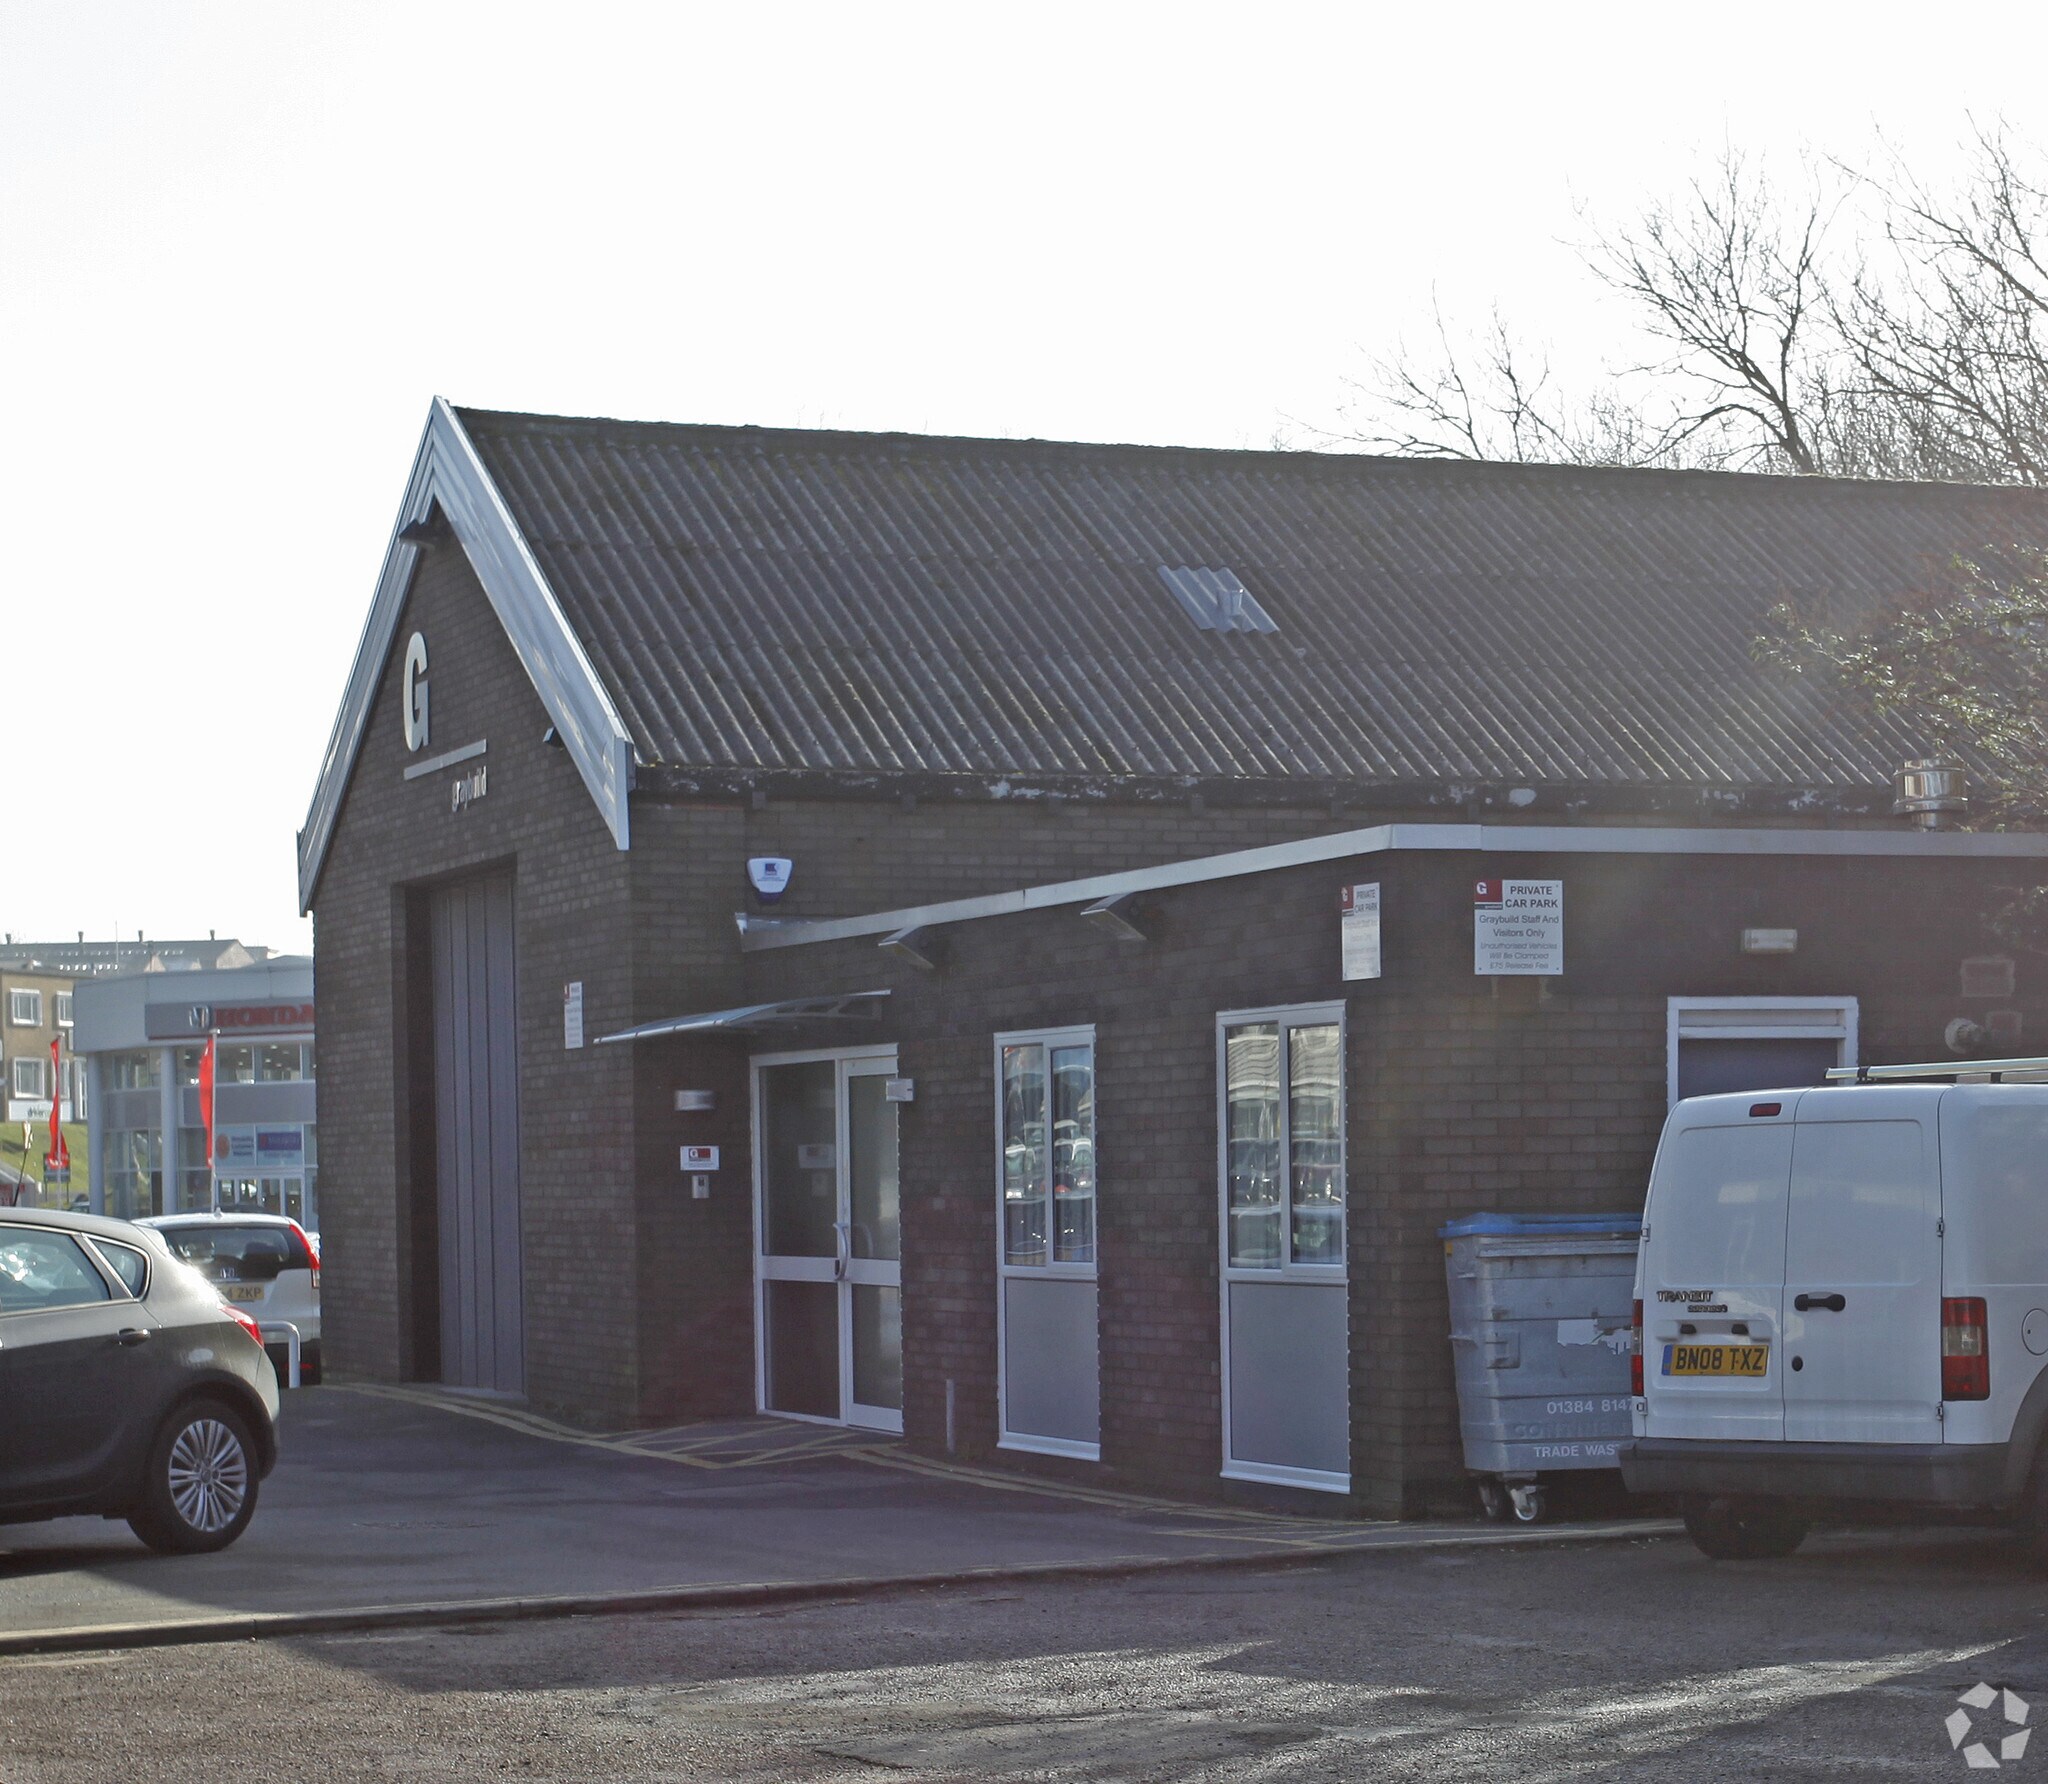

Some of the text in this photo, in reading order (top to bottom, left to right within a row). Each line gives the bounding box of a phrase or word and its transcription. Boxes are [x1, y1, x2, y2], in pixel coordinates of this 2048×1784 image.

[403, 631, 429, 752] G
[1476, 882, 1487, 895] G
[1510, 886, 1553, 896] PRIVATE
[1365, 902, 1377, 911] PARK
[1505, 899, 1527, 908] CAR
[1530, 899, 1558, 908] PARK
[1479, 914, 1559, 925] Graybuild Staff And
[1493, 928, 1546, 939] Visitors Only
[1503, 952, 1513, 960] Be
[1656, 1290, 1713, 1303] TRANSIT
[1675, 1347, 1765, 1371] BN08 TXZ
[1546, 1400, 1594, 1414] 01384
[1533, 1445, 1579, 1458] TRADE
